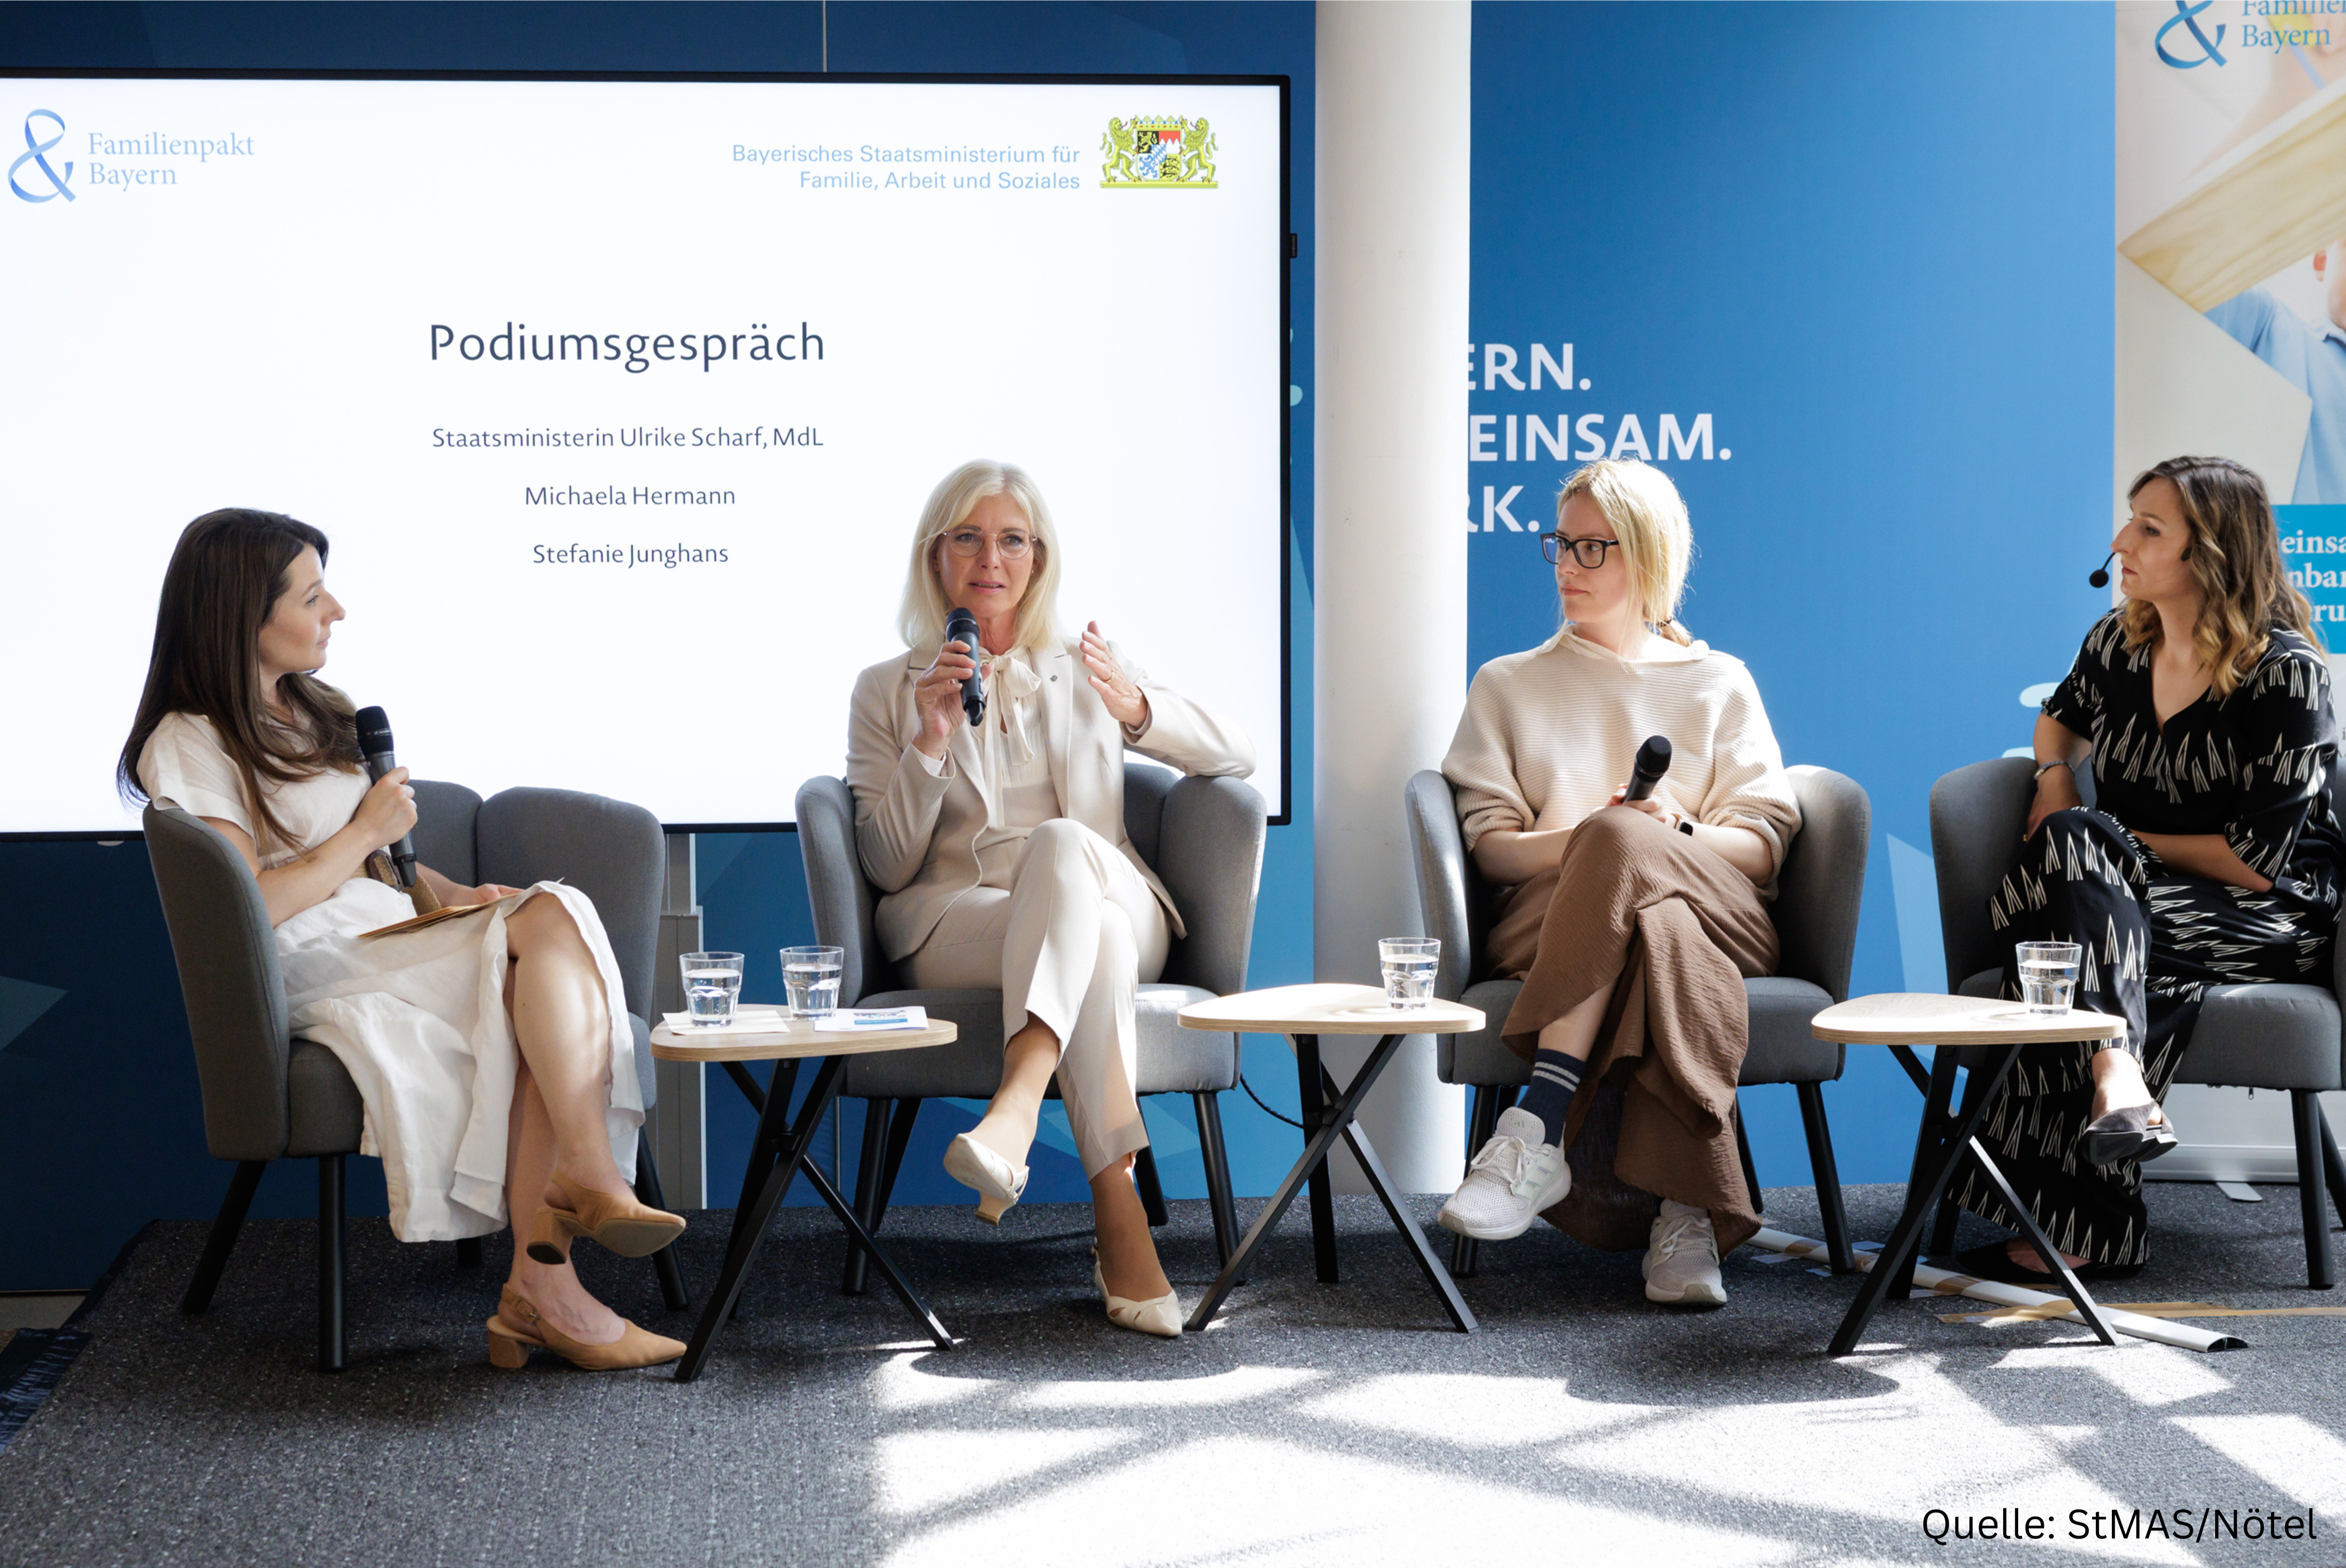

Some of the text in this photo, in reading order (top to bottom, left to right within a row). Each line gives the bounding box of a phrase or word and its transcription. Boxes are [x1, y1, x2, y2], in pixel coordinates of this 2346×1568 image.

[2241, 24, 2331, 54] Bayern
[88, 131, 255, 162] Familienpakt
[732, 144, 1081, 164] Bayerisches Staatsministerium für
[88, 162, 177, 192] Bayern
[800, 171, 1081, 191] Familie, Arbeit und Soziales
[430, 321, 825, 375] Podiumsgespräch
[1468, 343, 1591, 391] RN.
[432, 426, 824, 450] Staatsministerin Ulrike Scharf, MdL
[525, 484, 735, 506] Michaela Hermann
[533, 542, 729, 569] Stefanie Junghans
